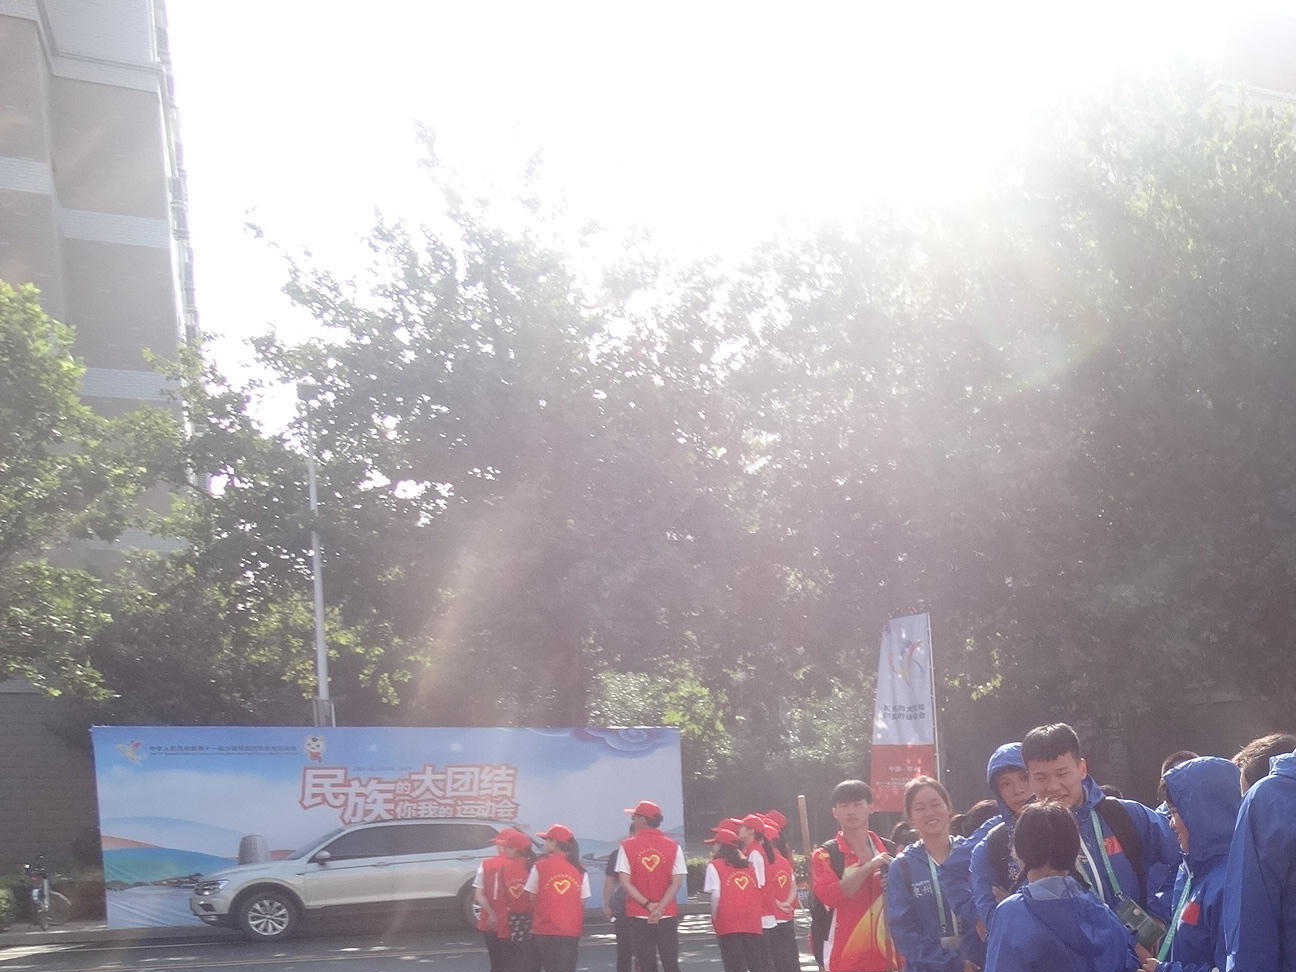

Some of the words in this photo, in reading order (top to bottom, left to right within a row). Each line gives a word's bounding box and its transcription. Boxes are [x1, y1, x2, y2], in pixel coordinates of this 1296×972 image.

[303, 765, 515, 823] 民族的大团结
[395, 801, 517, 819] 你我的运动会
